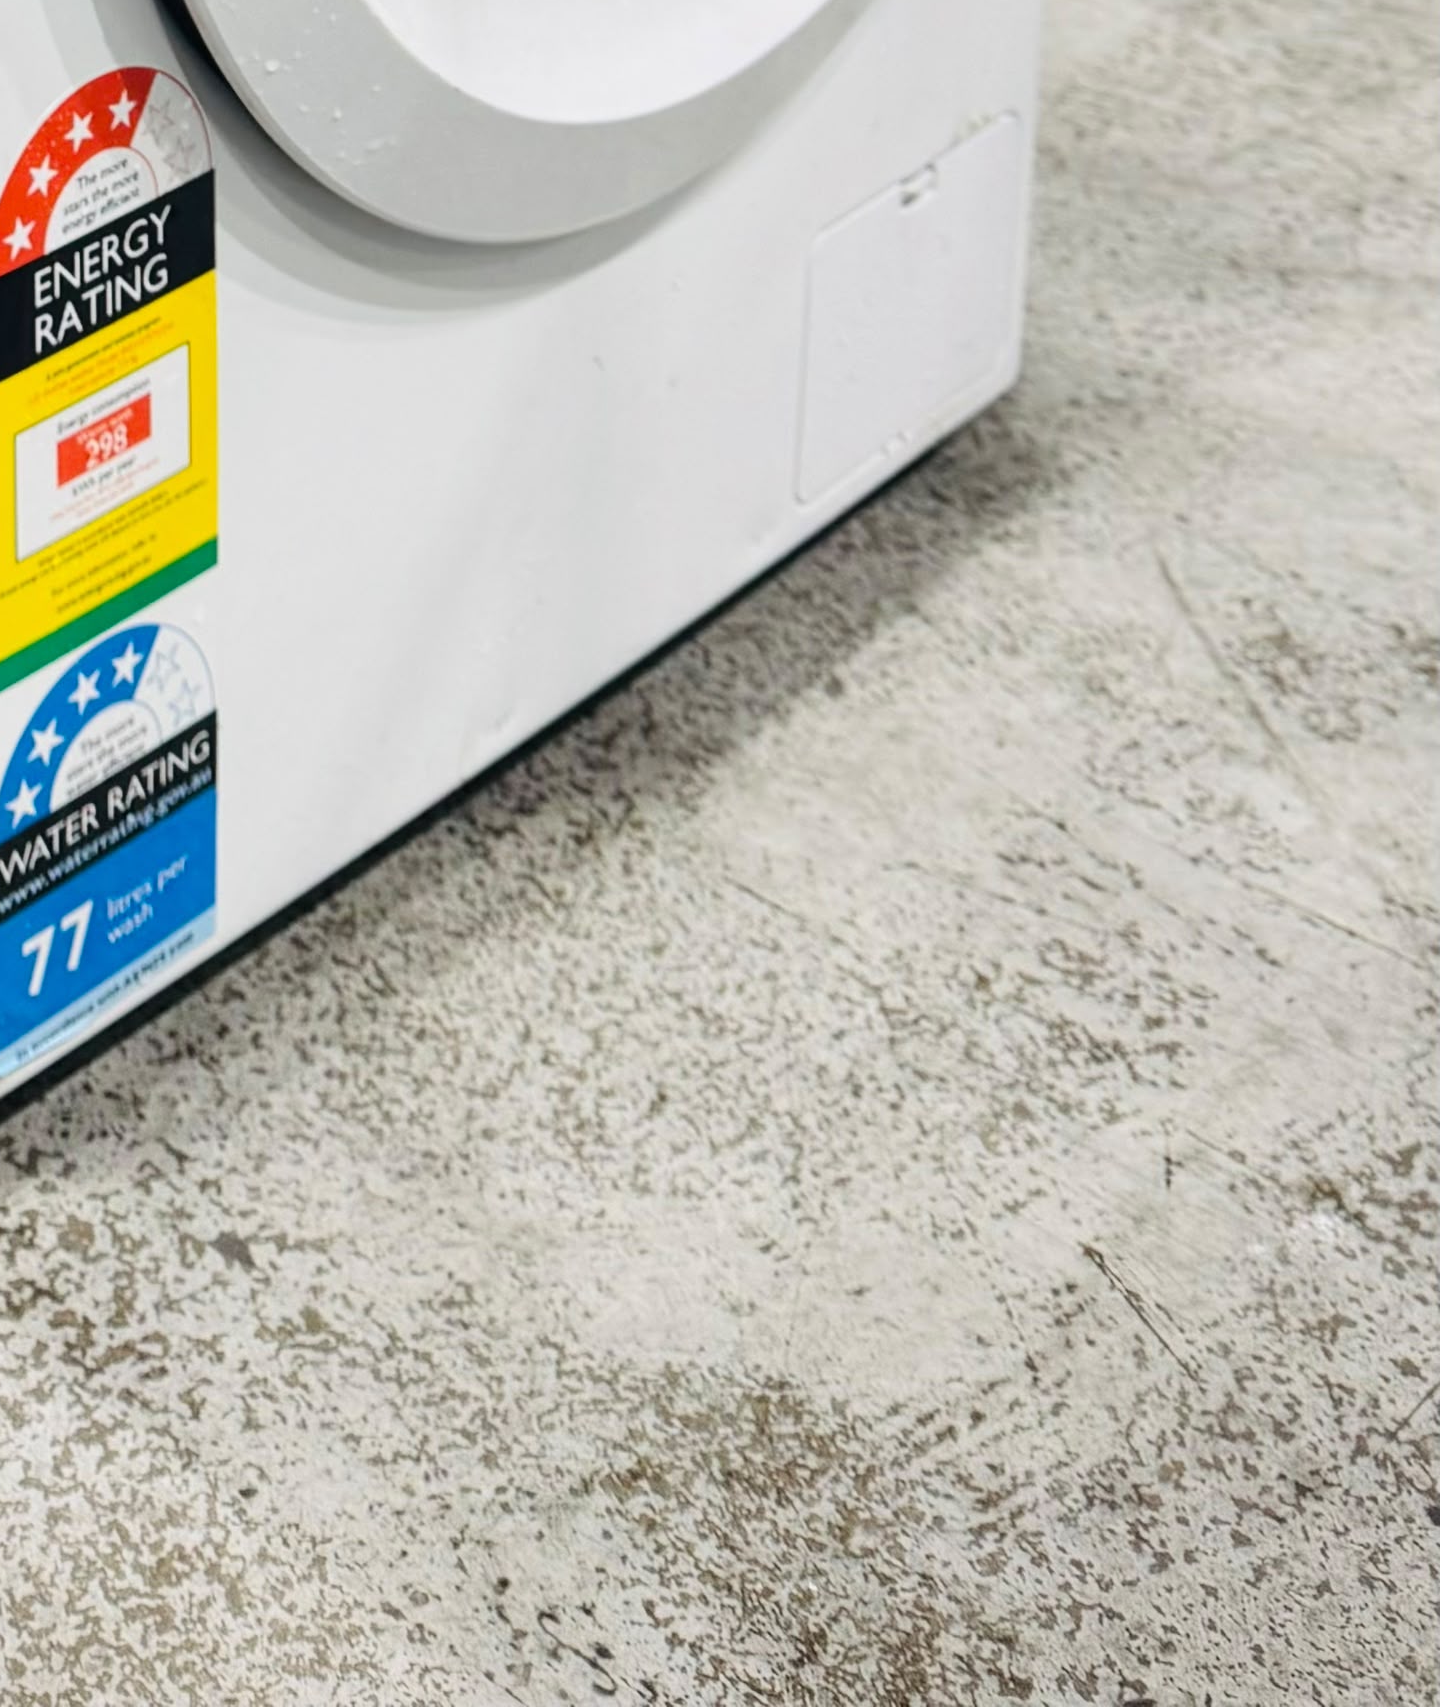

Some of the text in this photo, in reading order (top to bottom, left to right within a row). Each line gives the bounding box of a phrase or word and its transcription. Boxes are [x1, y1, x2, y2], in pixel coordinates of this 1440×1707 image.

[34, 204, 171, 309] ENERGY
[34, 253, 168, 355] RATING
[86, 422, 128, 470] 298
[107, 729, 210, 820] RATING
[21, 854, 188, 997] 77 litres per
[107, 902, 153, 944] wash
